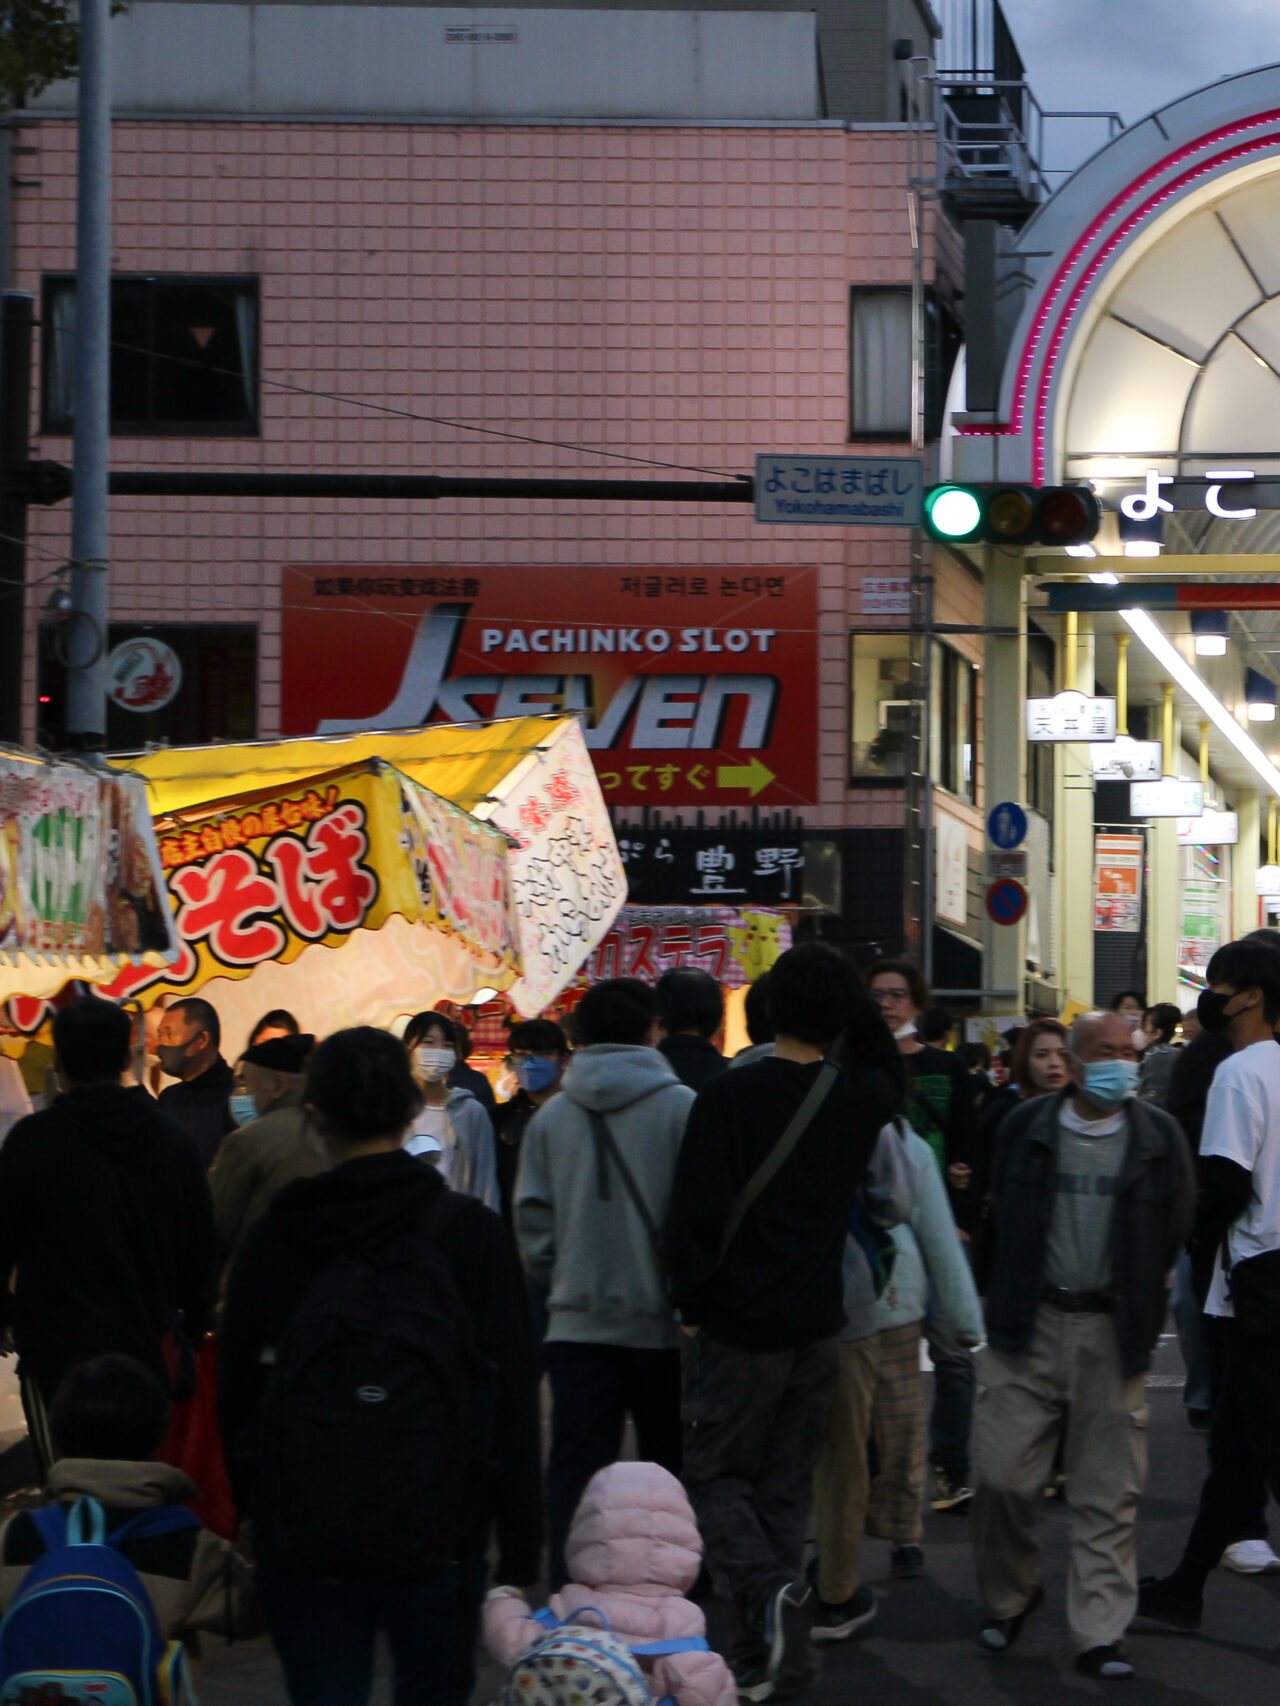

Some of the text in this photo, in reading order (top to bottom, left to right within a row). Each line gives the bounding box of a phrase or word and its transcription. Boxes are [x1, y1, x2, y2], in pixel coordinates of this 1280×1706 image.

[764, 466, 913, 496] よこはまばし
[775, 500, 905, 517] Yokohamabashi
[482, 629, 777, 653] PACHINKO SLOT
